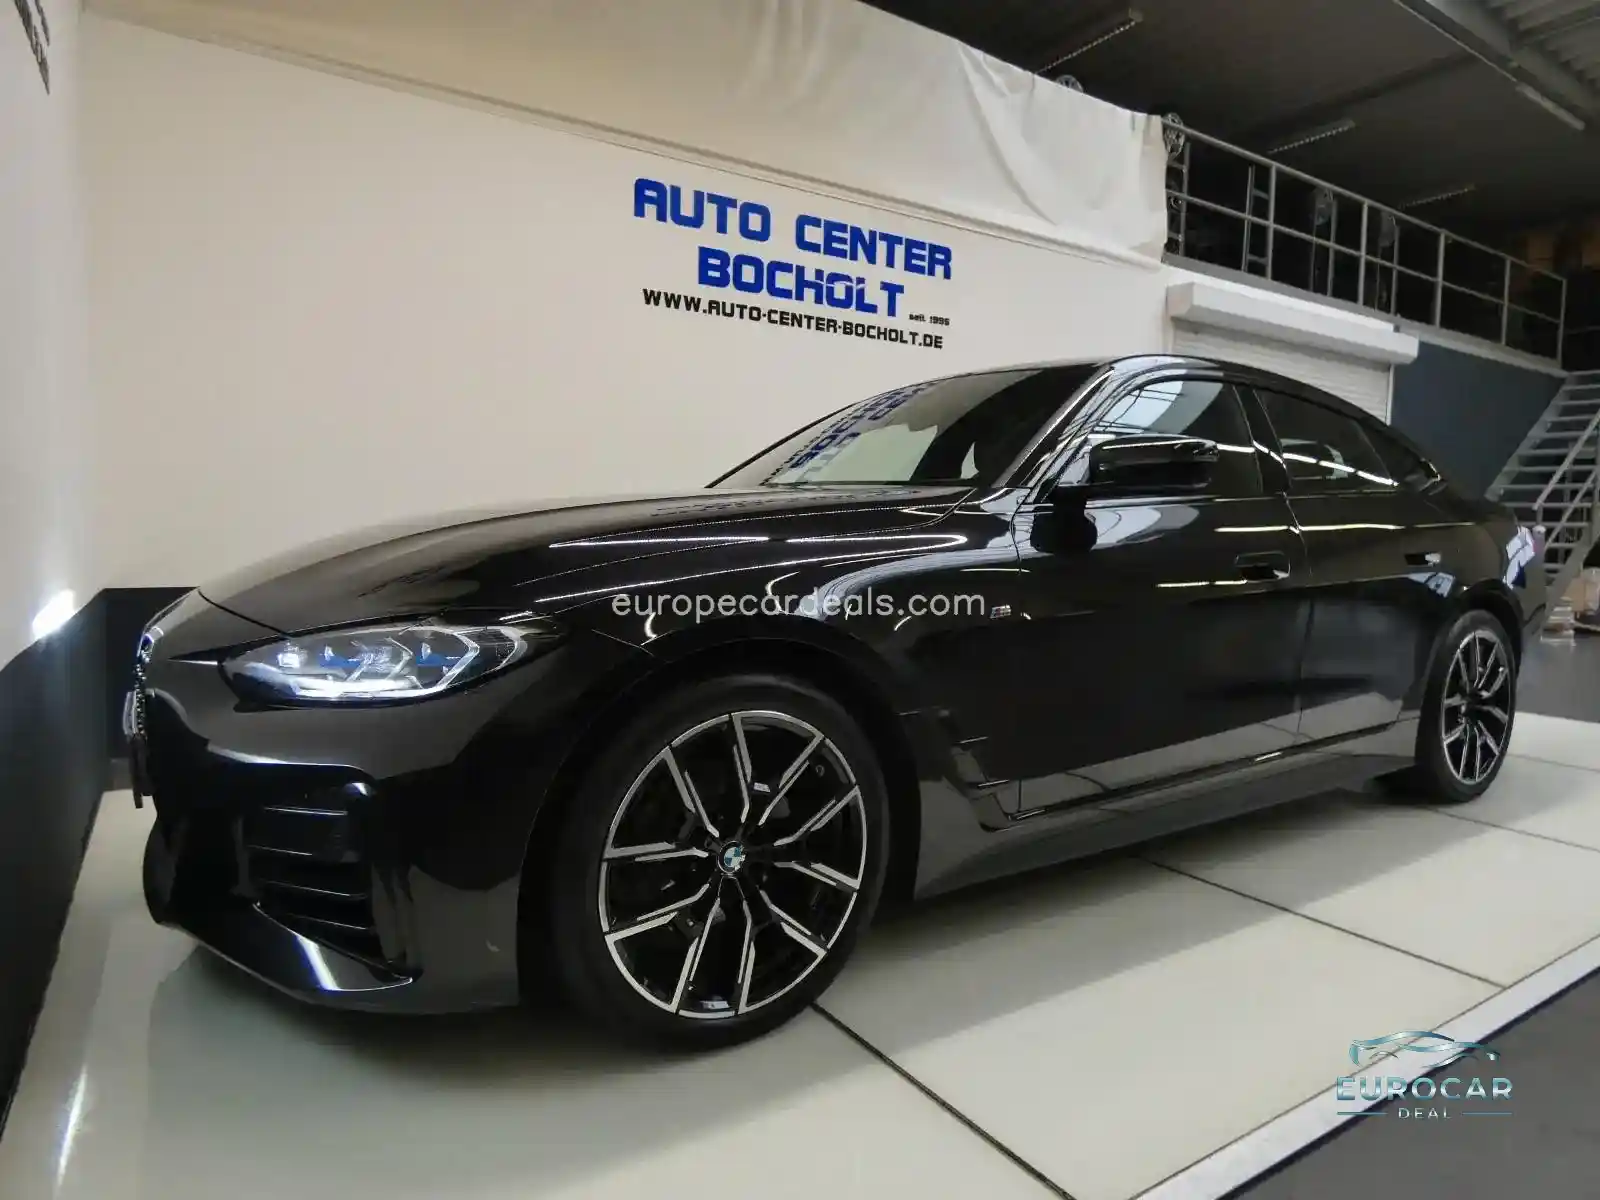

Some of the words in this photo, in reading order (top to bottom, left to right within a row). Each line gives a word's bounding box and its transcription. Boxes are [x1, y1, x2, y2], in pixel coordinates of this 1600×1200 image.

[633, 177, 771, 242] AUTO
[795, 213, 953, 280] CENTER
[698, 246, 904, 317] BOCHOLT
